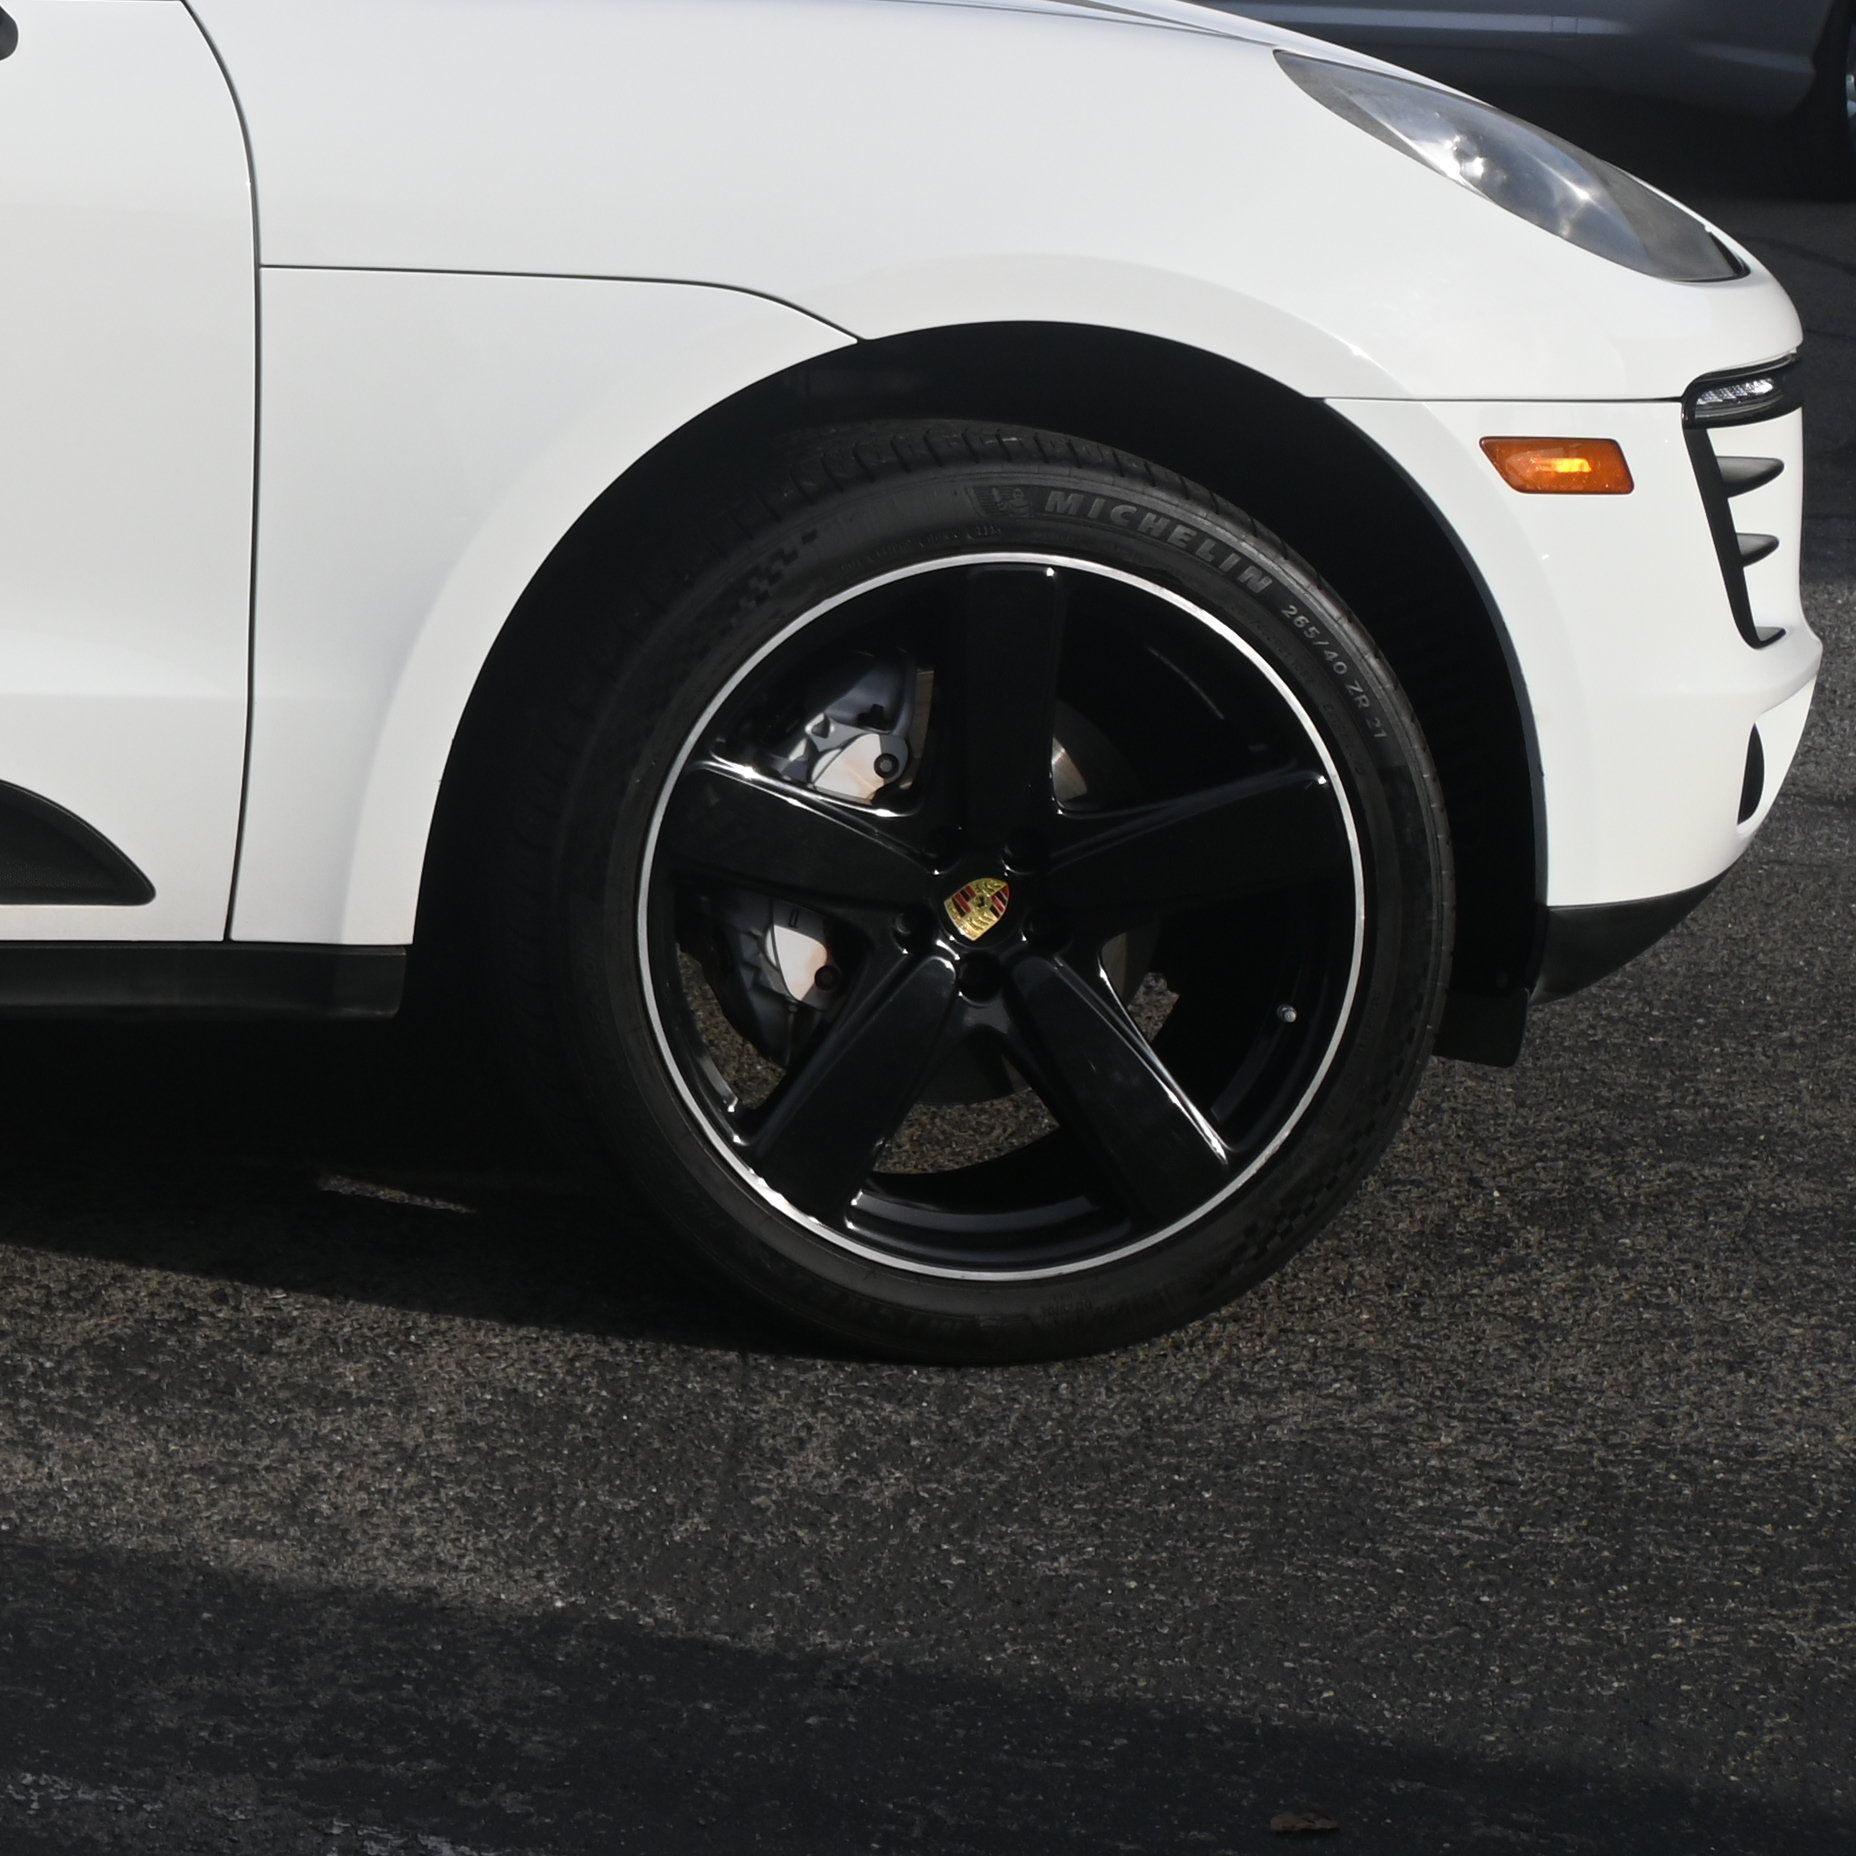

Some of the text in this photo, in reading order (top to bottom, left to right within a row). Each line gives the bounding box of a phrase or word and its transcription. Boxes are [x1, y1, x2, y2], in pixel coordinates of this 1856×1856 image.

[1044, 490, 1273, 594] MICHELIN
[1281, 604, 1348, 676] 265/40
[1344, 682, 1371, 710] ZR
